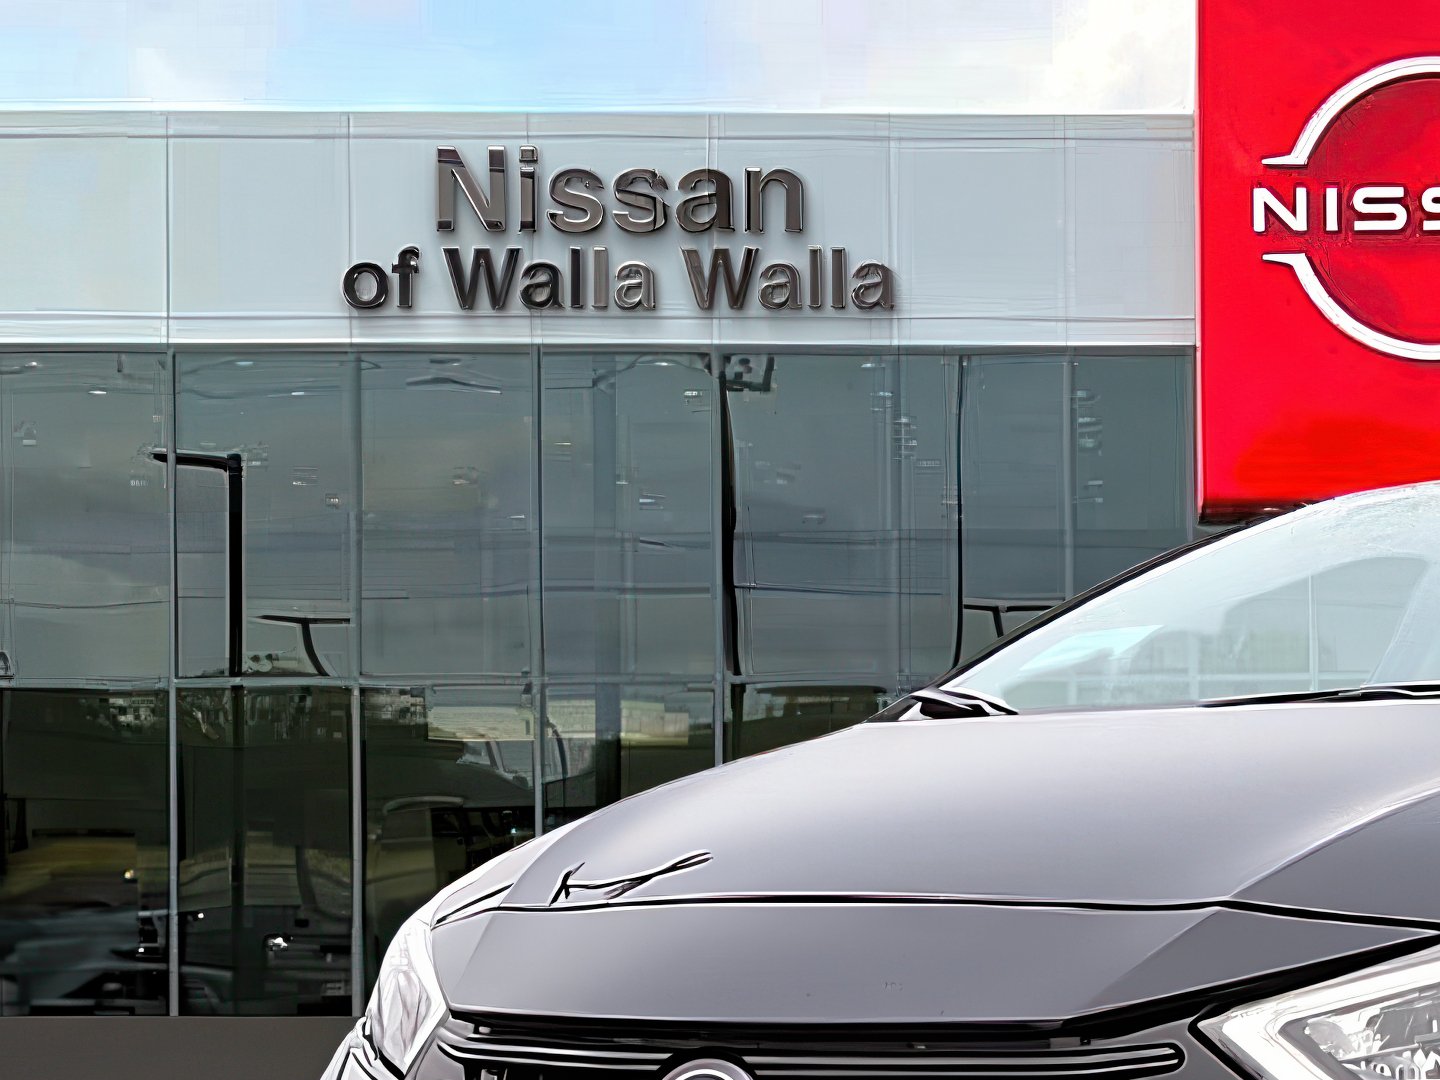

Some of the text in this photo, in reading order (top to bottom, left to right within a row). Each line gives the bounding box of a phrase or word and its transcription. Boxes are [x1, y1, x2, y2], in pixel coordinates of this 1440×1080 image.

[435, 143, 806, 233] Nissan
[341, 246, 896, 310] of Walla Walla
